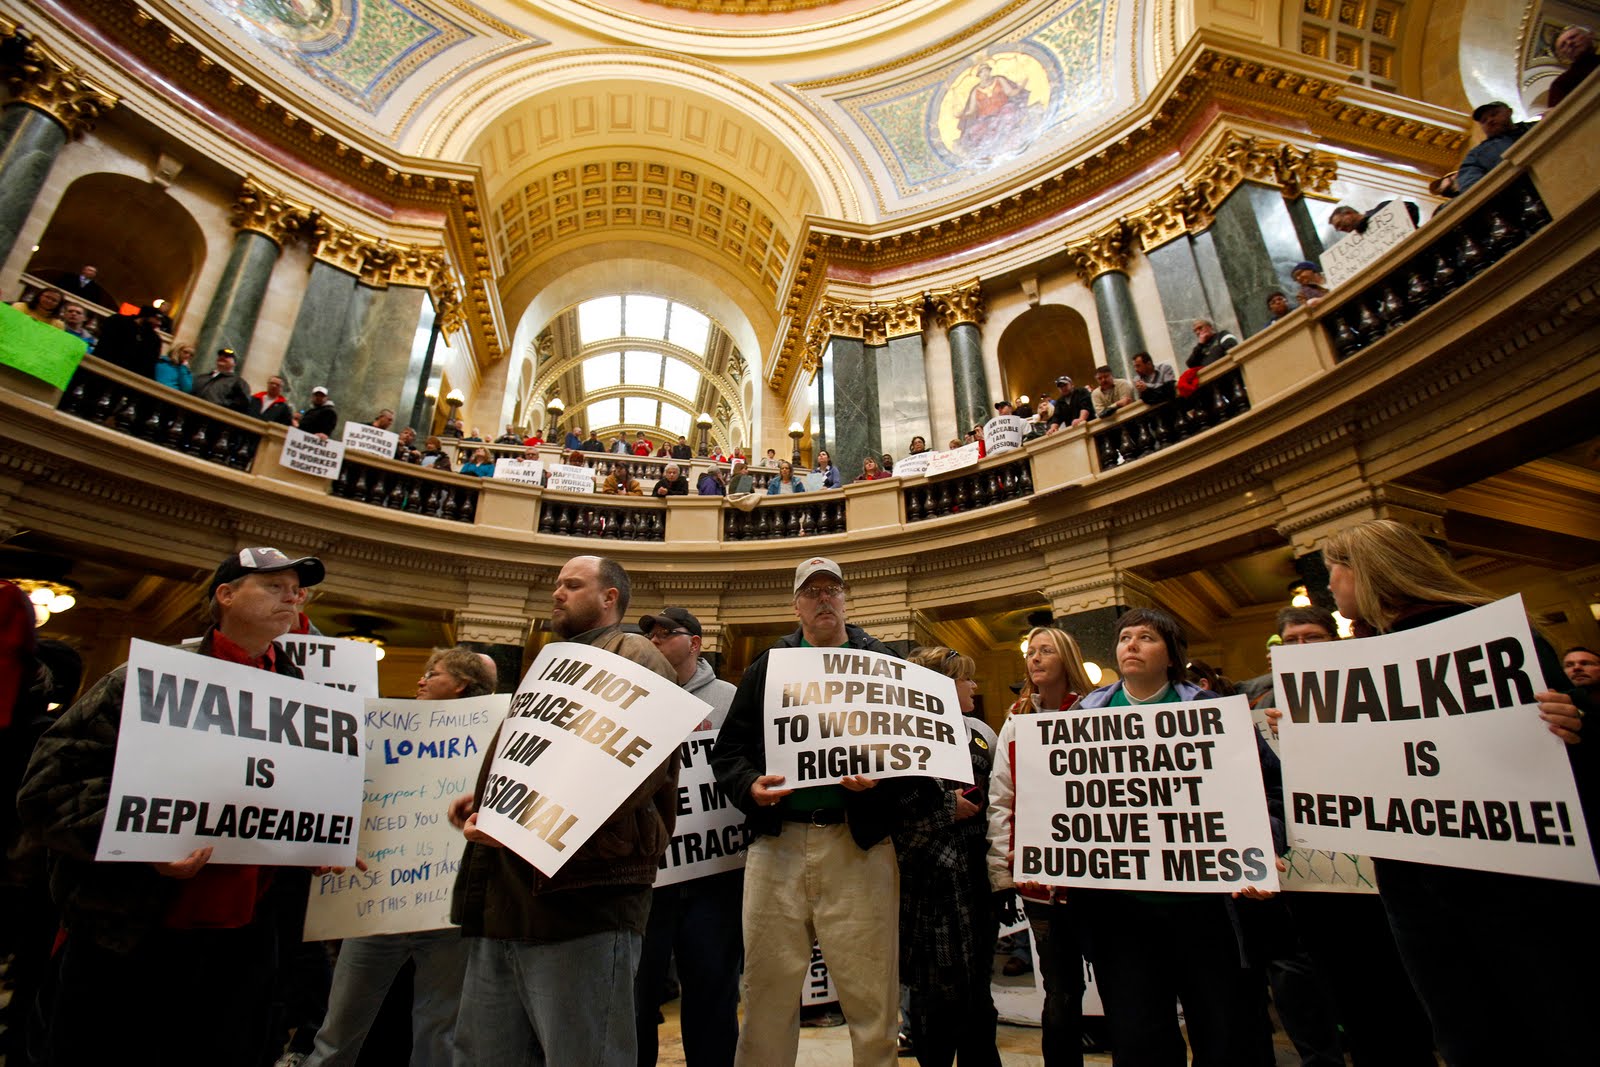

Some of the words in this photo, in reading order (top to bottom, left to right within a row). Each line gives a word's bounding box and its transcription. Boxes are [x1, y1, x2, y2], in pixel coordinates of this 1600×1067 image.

[303, 434, 329, 449] WHAT
[349, 432, 393, 448] HAPPENED
[361, 426, 384, 437] WHAT
[286, 448, 297, 458] TO
[298, 454, 337, 468] WORKER
[290, 440, 338, 459] HAPPENED
[345, 439, 356, 447] TO
[358, 441, 392, 457] WORKER
[290, 461, 329, 476] RIGHTS?
[553, 471, 590, 480] HAPPENED
[561, 478, 592, 487] WORKER
[285, 641, 336, 668] N'T
[822, 653, 907, 681] WHAT
[538, 657, 557, 681] I
[548, 658, 593, 686] AM
[582, 669, 651, 710] NOT
[1280, 636, 1537, 724] WALKER
[137, 667, 359, 757] WALKER
[781, 681, 945, 715] HAPPENED
[364, 710, 422, 732] RKING
[429, 709, 489, 728] FAMILIES
[774, 714, 809, 746] TO
[818, 710, 957, 746] WORKER
[1037, 713, 1144, 746] TAKING
[1155, 707, 1225, 739] OUR
[384, 734, 478, 765] LOMIRA
[498, 731, 518, 759] I
[503, 732, 552, 767] AM
[1049, 741, 1215, 776] CONTRACT
[1403, 740, 1441, 777] IS
[245, 756, 275, 789] IS
[797, 743, 932, 782] RIGHTS?
[436, 777, 467, 800] YOU
[1065, 776, 1203, 809] DOESN'T
[115, 795, 354, 845] REPLACEABLE!
[364, 815, 407, 831] NEED
[414, 811, 439, 830] YOU
[1051, 812, 1150, 843] SOLVE
[1157, 811, 1228, 843] THE
[1292, 792, 1576, 847] REPLACEABLE!
[366, 844, 407, 863] upport
[1021, 846, 1150, 881] BUDGET
[1161, 847, 1268, 882] MESS
[320, 871, 384, 895] PLEASE
[391, 861, 432, 886] DON'T
[357, 901, 373, 917] UP
[378, 896, 407, 913] THIS
[415, 887, 448, 905] BILL!
